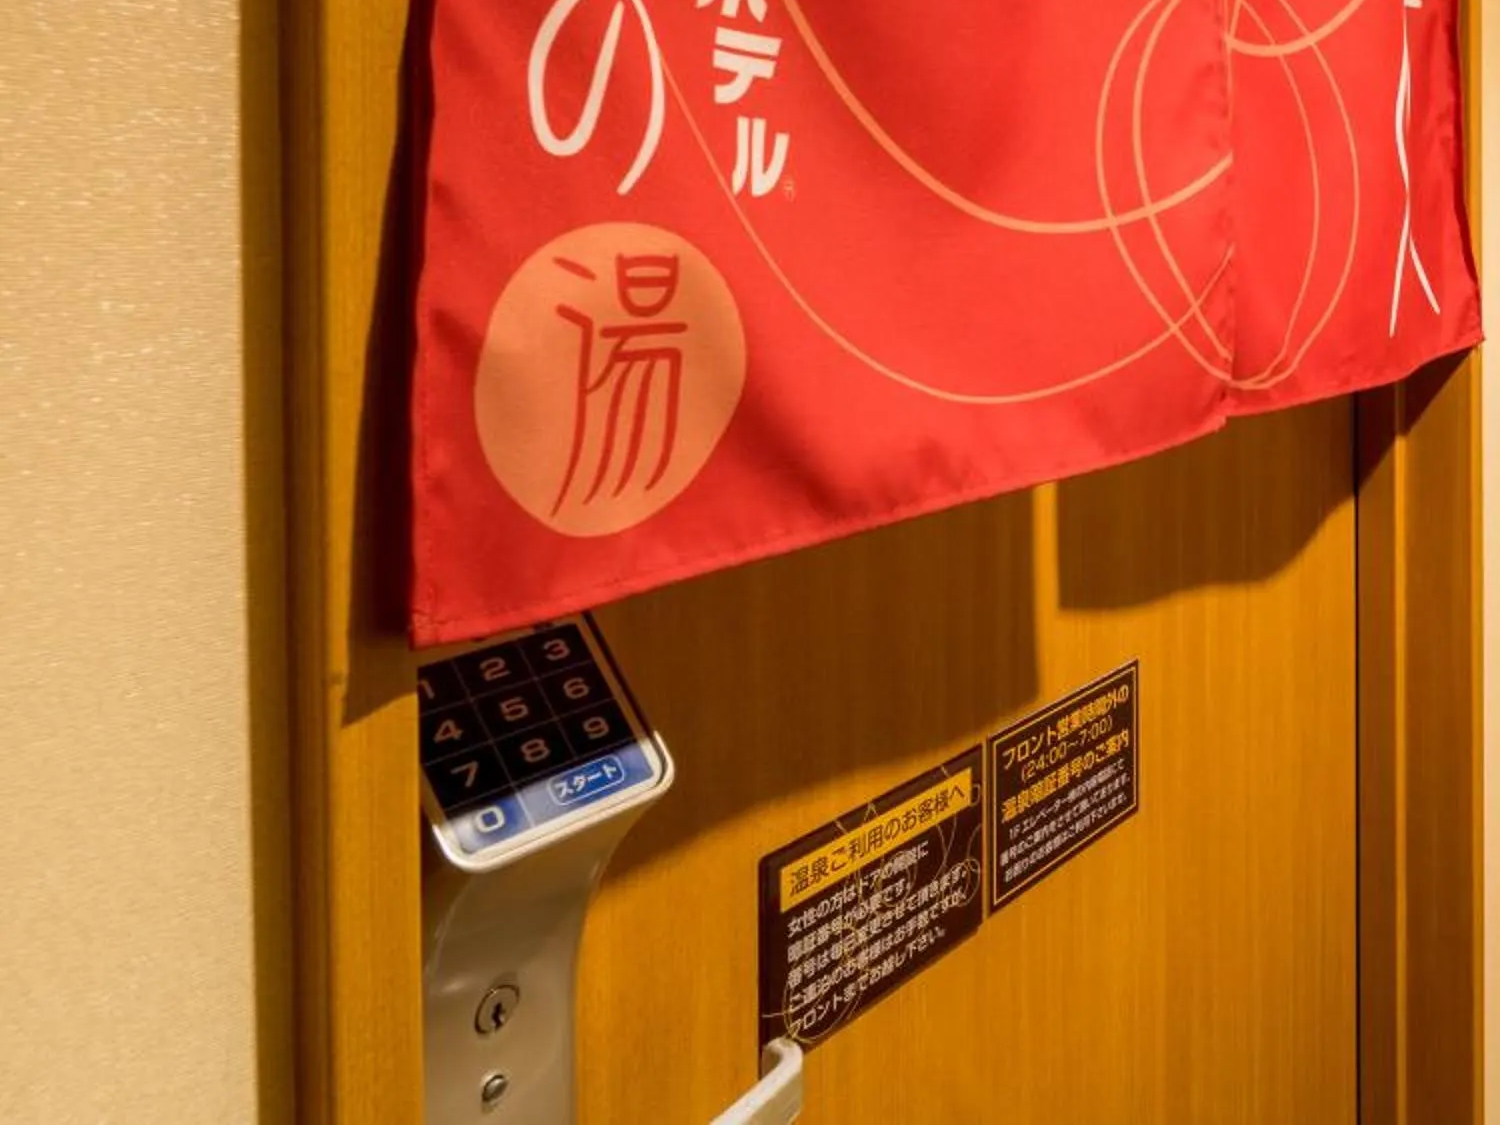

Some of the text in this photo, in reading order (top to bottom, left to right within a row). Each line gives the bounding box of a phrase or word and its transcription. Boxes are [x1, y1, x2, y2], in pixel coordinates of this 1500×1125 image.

[479, 657, 511, 682] 2
[543, 638, 571, 661] 3
[433, 677, 590, 743] 4 5 6
[451, 716, 609, 788] 7 8 9
[555, 762, 618, 798] スタート
[475, 805, 506, 833] 0
[790, 783, 966, 895] 温泉ご利用のお客様へ
